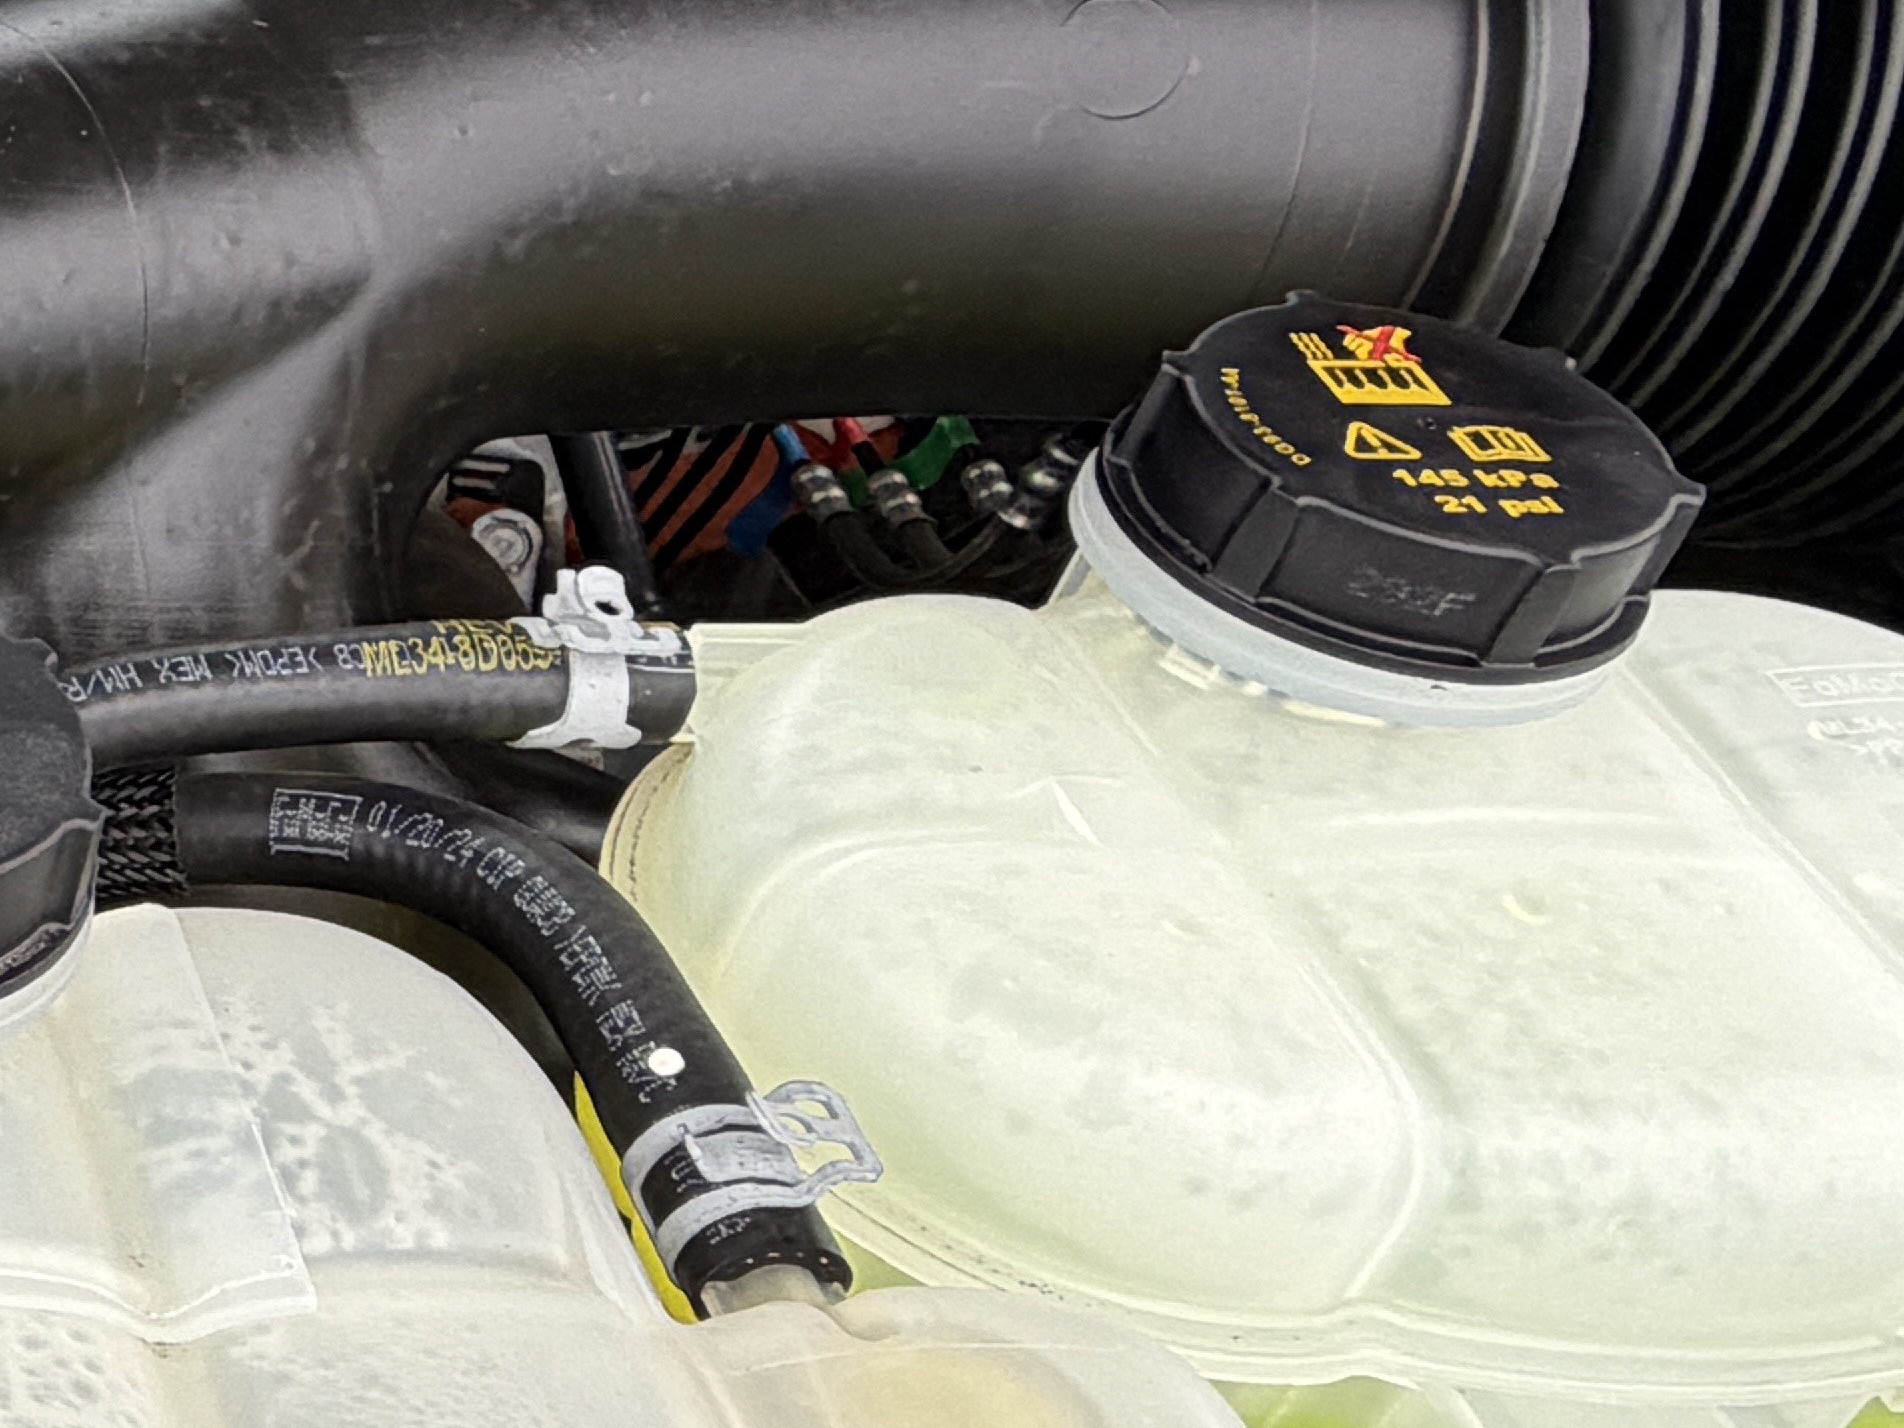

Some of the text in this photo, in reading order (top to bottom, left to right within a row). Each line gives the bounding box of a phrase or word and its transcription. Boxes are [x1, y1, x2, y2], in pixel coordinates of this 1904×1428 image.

[1393, 469, 1561, 489] 145 kPa
[1434, 495, 1566, 519] 21 psi
[152, 652, 214, 685] MEX
